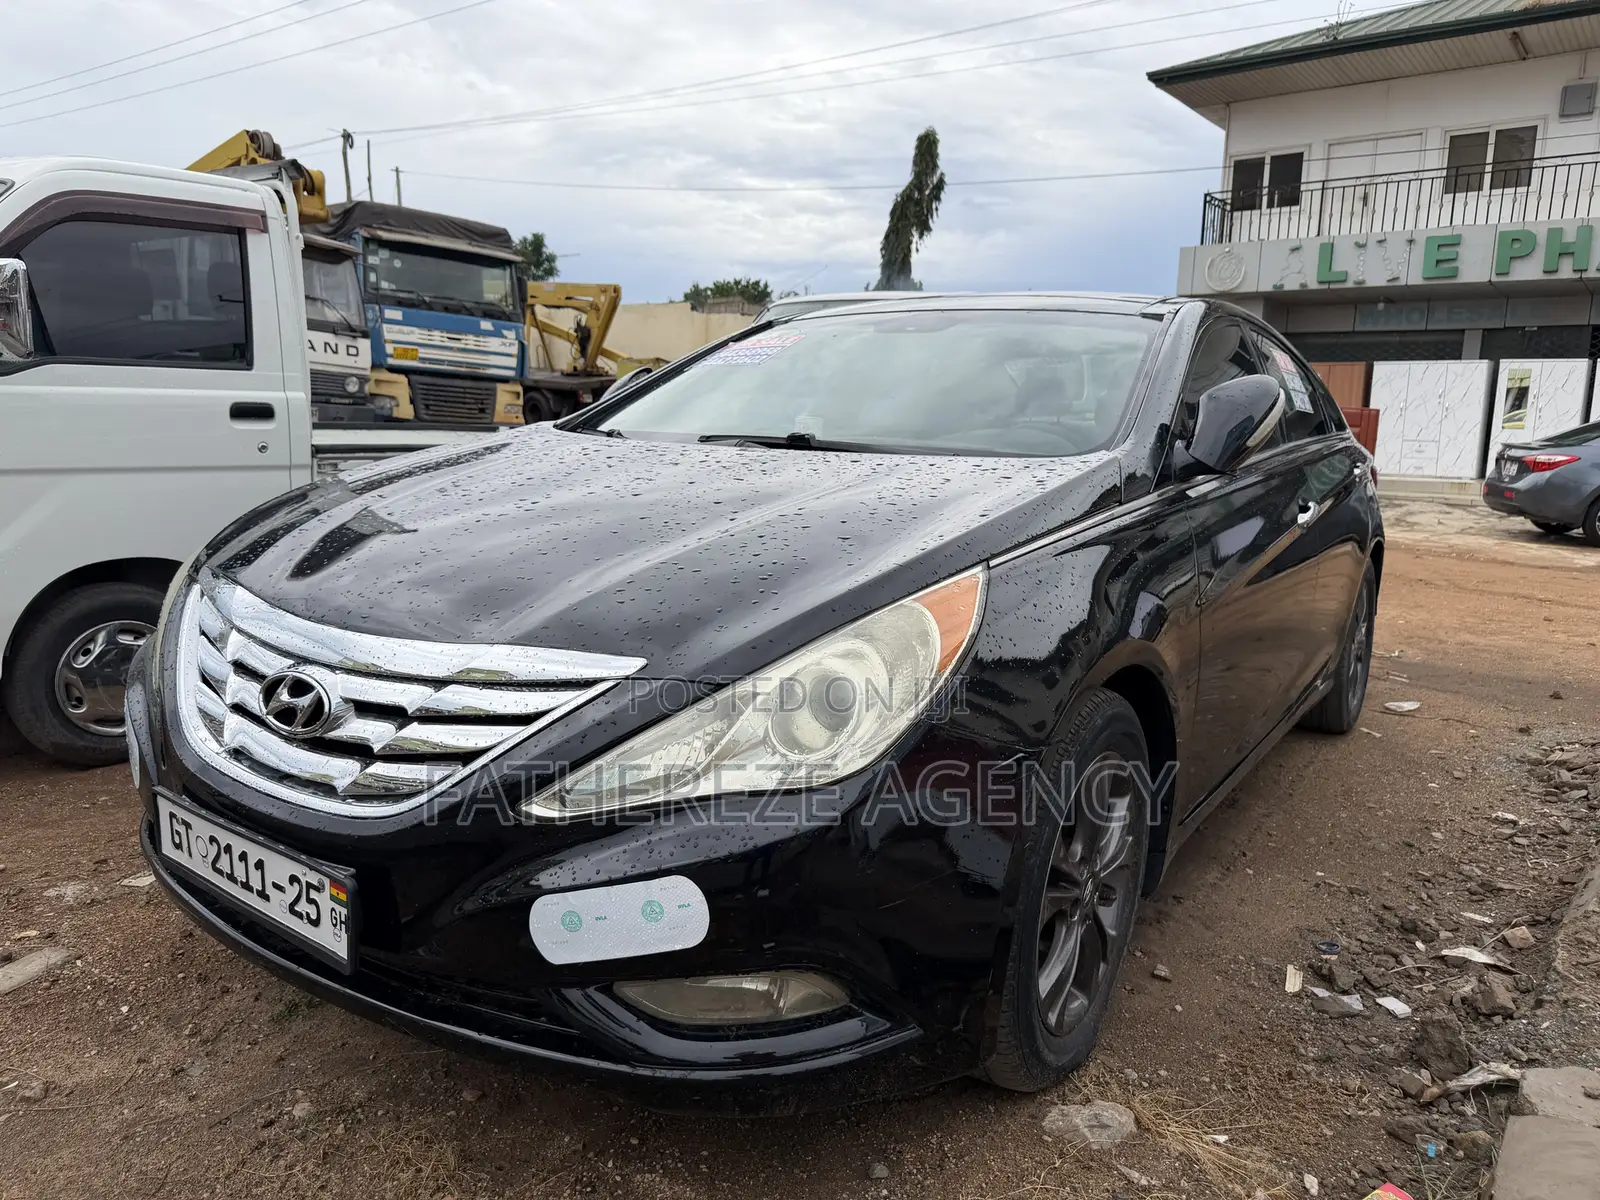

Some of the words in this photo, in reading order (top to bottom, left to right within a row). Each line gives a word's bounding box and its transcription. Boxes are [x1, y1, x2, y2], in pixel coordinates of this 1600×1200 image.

[1495, 224, 1600, 276] PH
[1357, 300, 1543, 329] WHOLESAL
[168, 810, 193, 858] GT
[208, 833, 323, 929] 2111-25
[329, 906, 350, 934] GH
